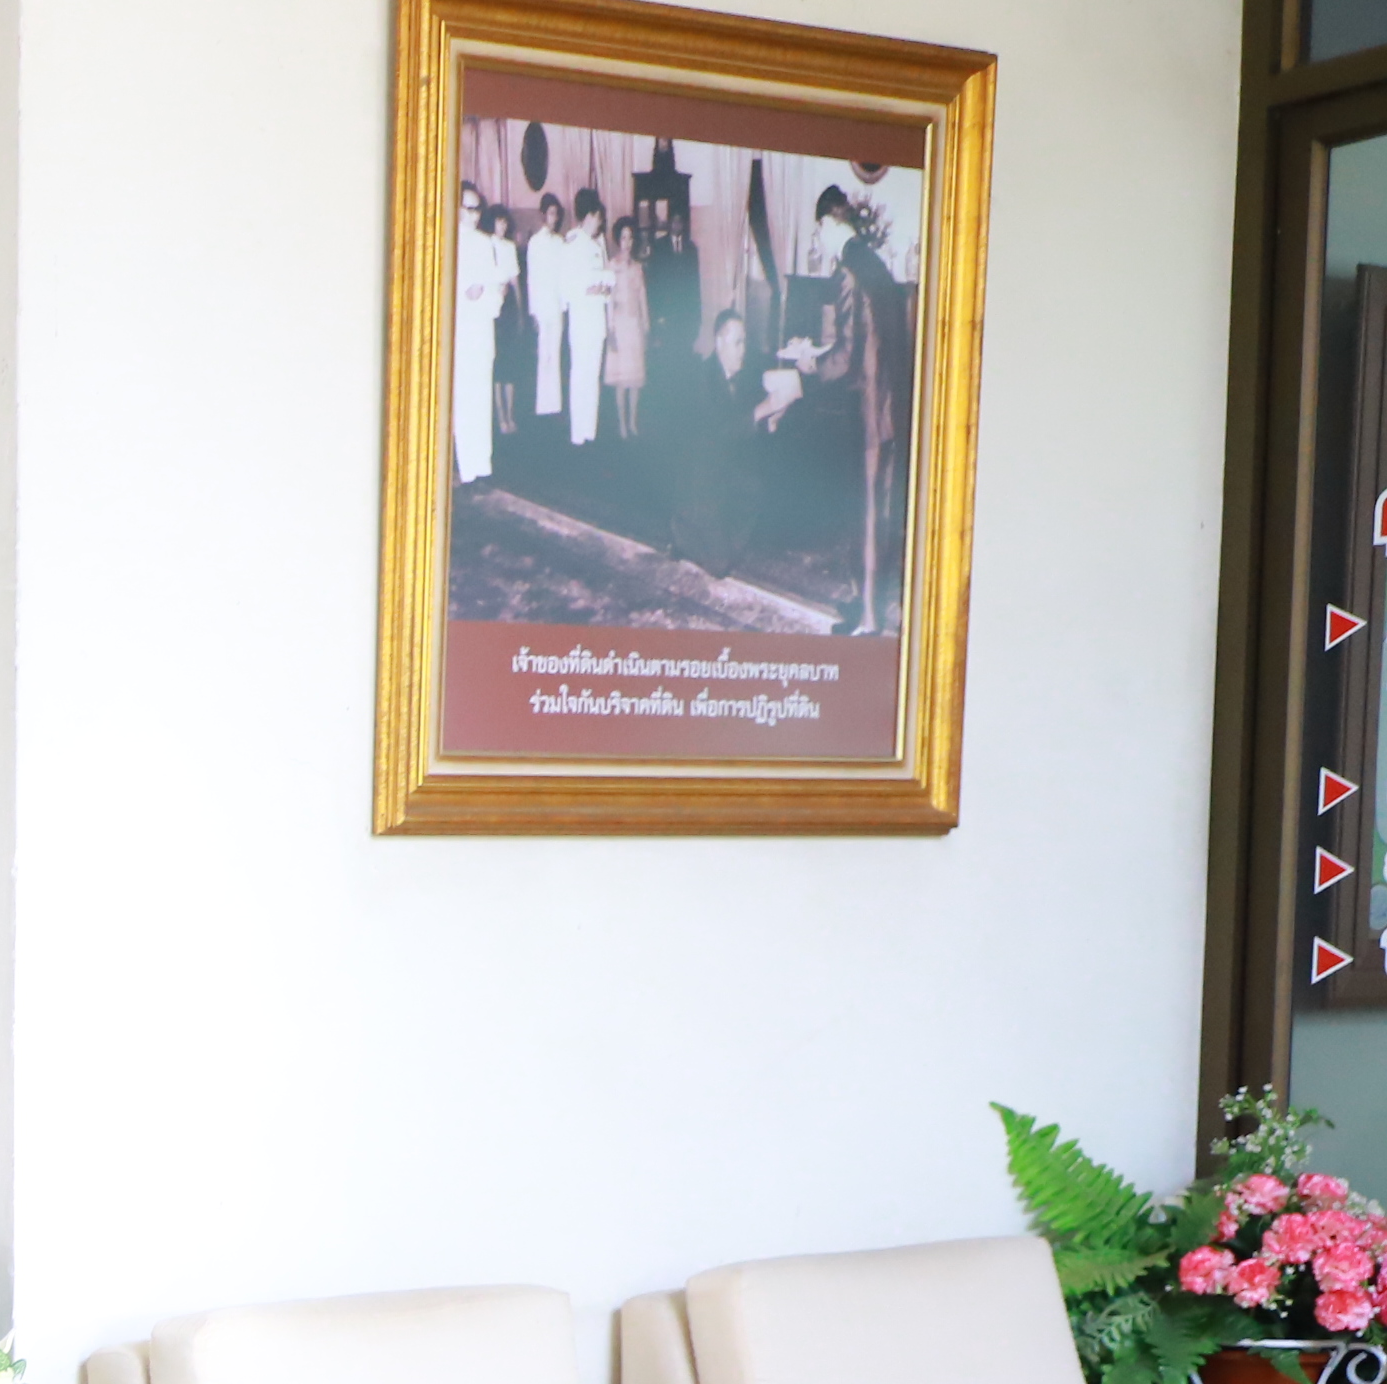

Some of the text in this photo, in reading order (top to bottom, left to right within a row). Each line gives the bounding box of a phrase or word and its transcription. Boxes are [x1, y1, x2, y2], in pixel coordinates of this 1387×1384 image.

[529, 685, 820, 726] ร่วมใจกันบริจาคที่ดิน เพื่อการปฏิรูปที่ดิน
